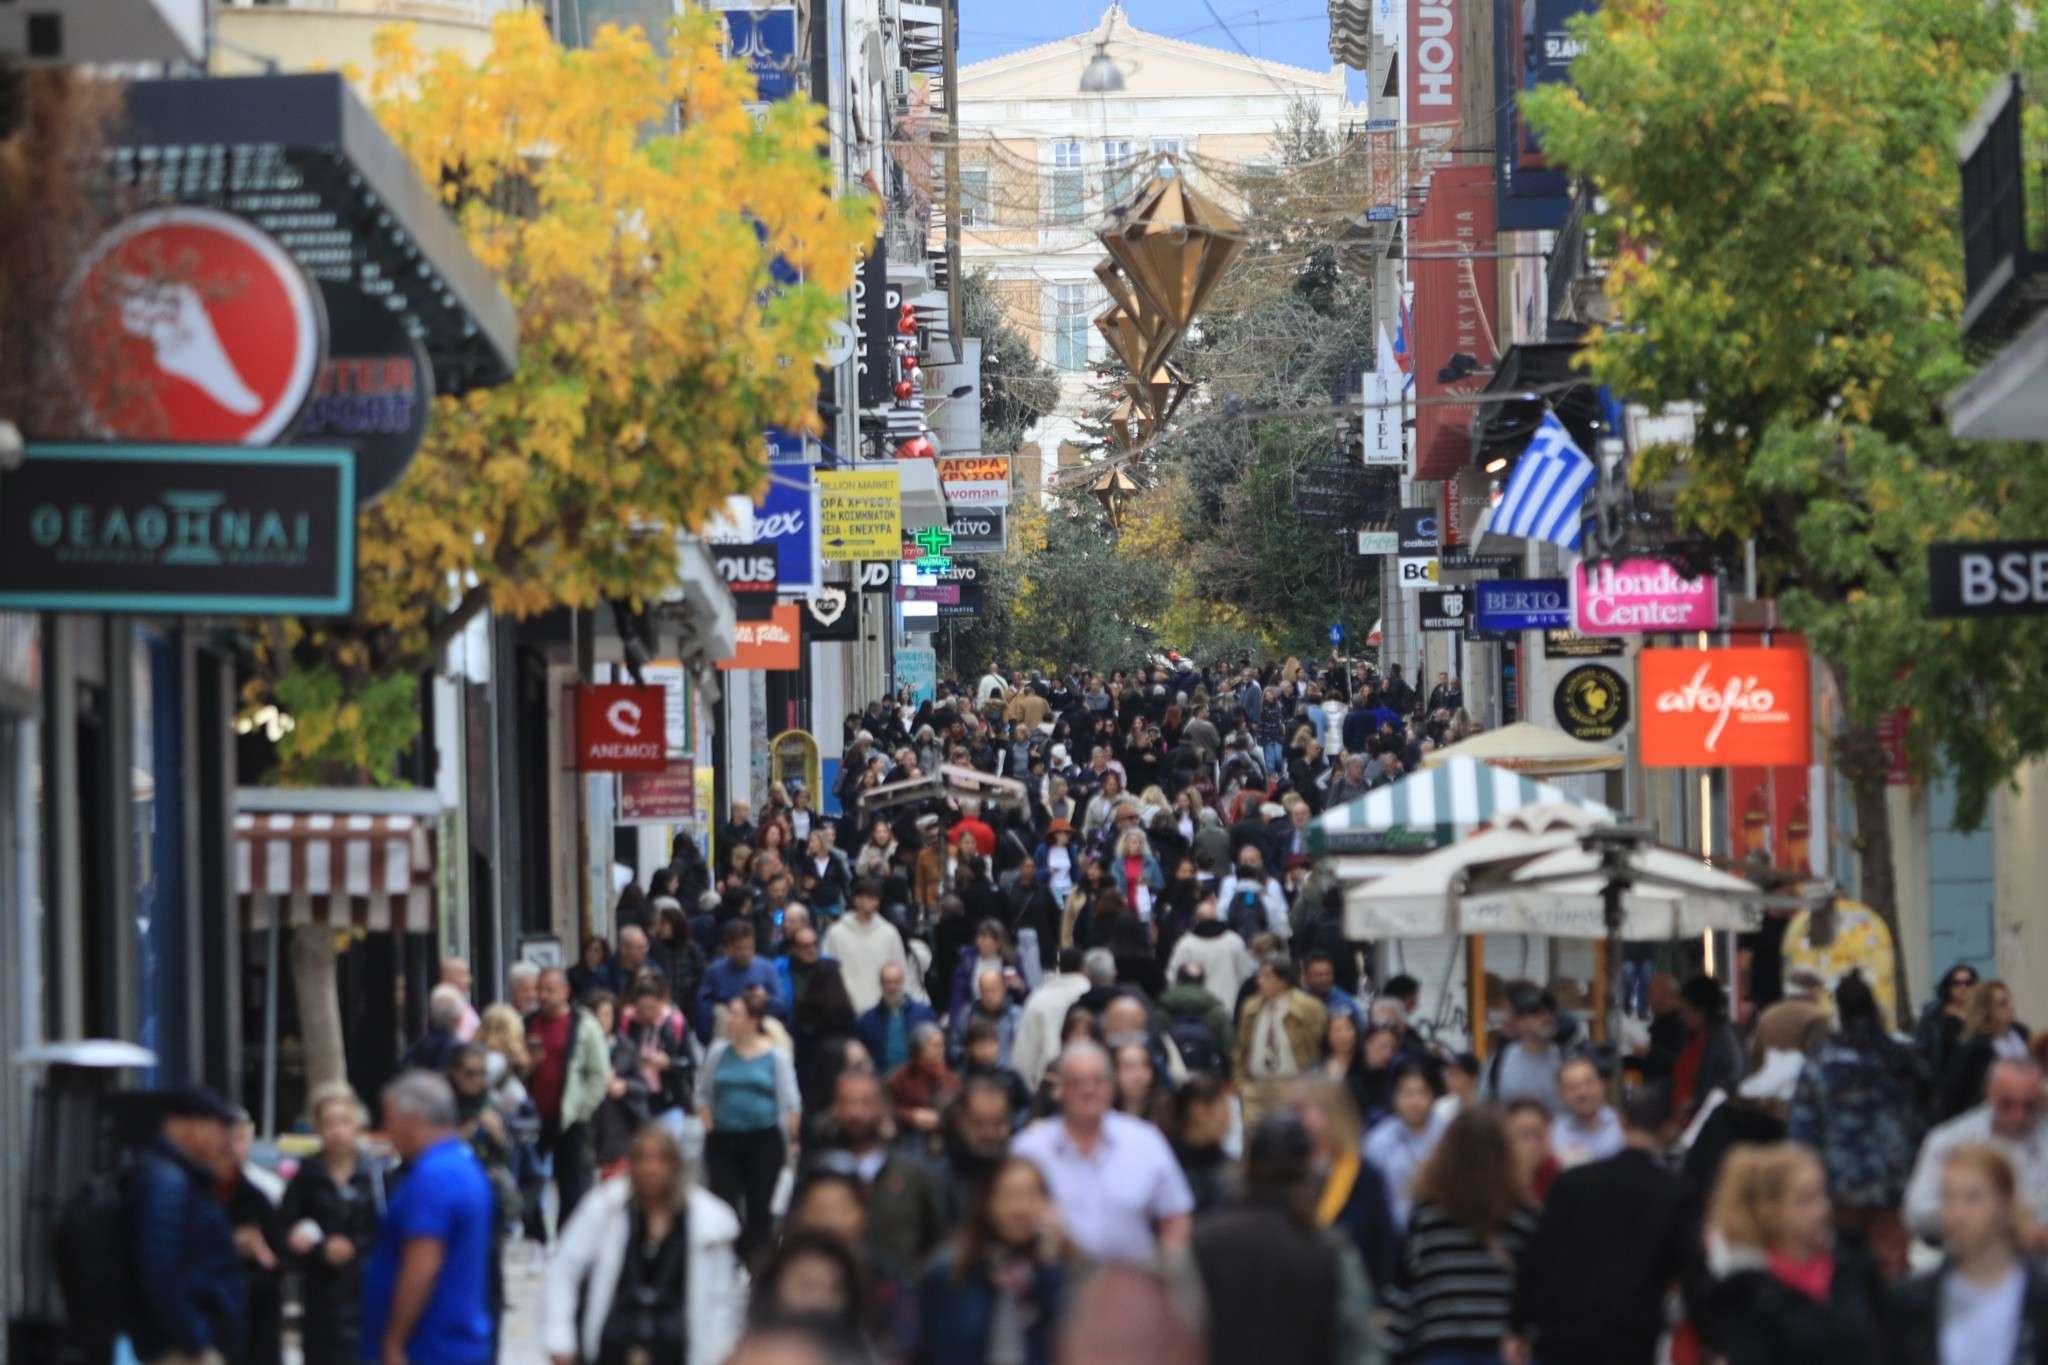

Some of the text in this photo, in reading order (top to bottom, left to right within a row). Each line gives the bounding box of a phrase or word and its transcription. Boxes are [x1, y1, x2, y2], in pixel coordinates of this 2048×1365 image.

[1418, 0, 1454, 106] HOU
[942, 457, 1000, 471] ΑΓΟΡΑ
[947, 488, 999, 500] woman
[1486, 591, 1560, 609] BERTO
[1586, 595, 1693, 626] Center
